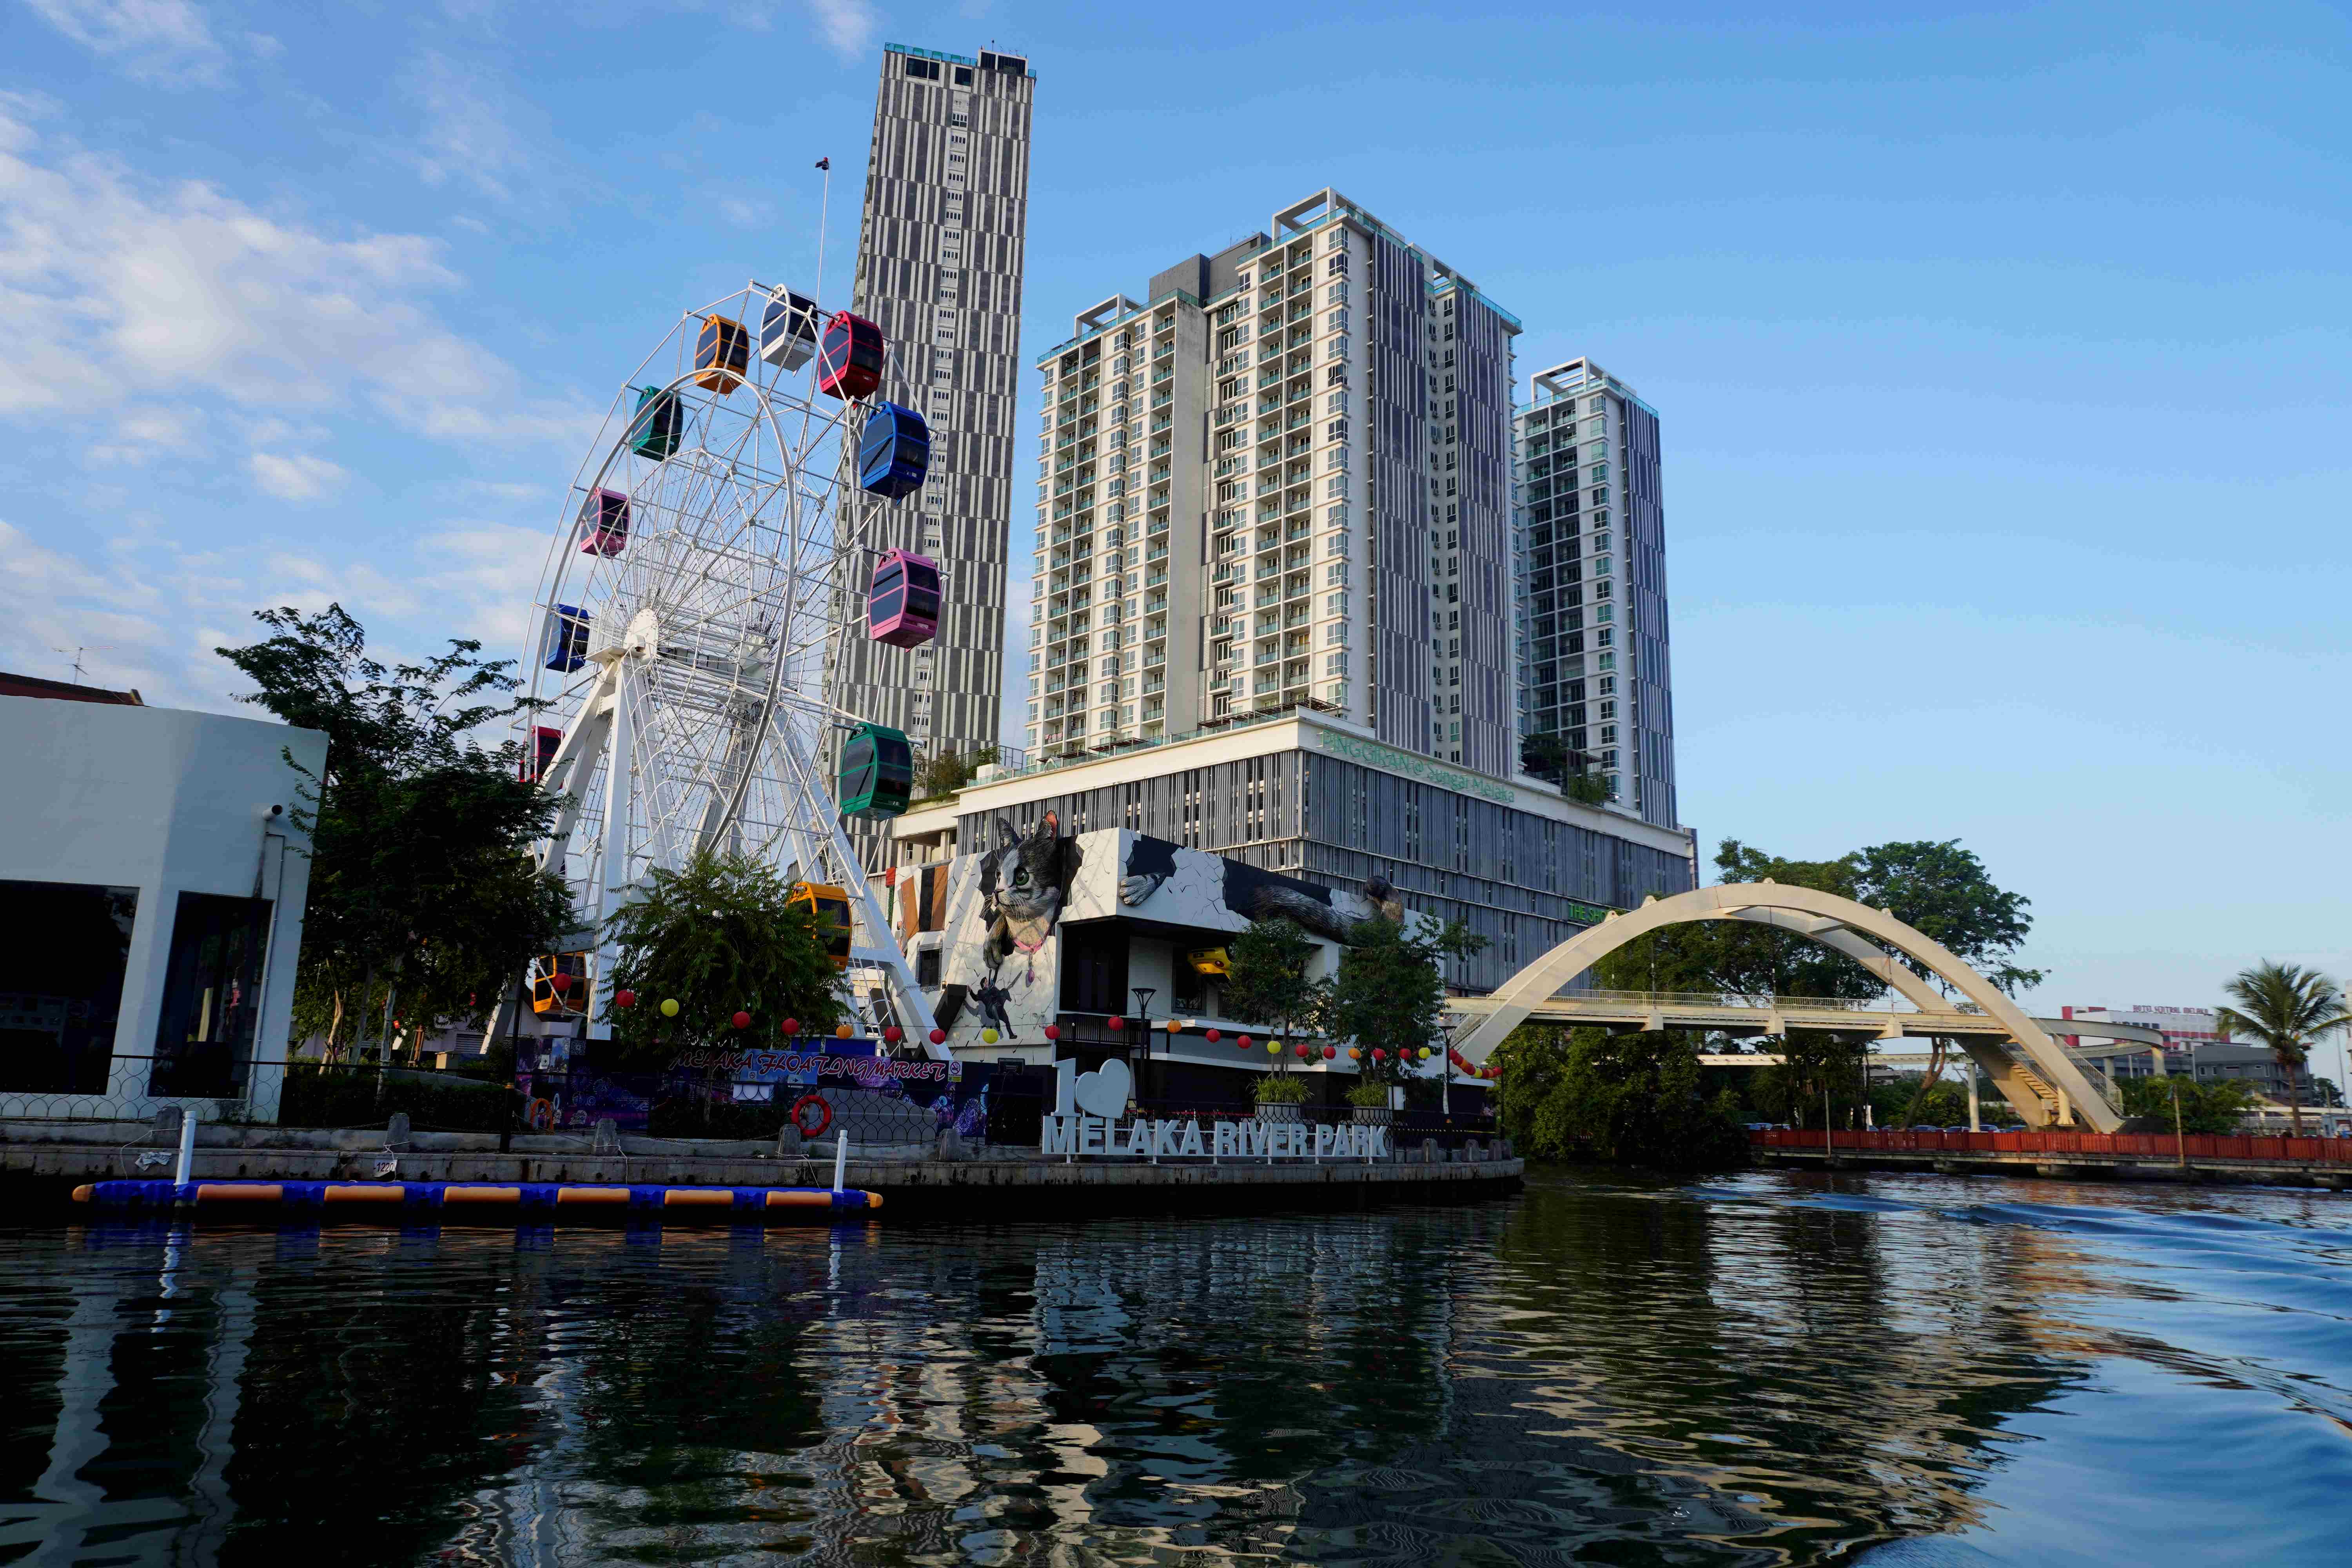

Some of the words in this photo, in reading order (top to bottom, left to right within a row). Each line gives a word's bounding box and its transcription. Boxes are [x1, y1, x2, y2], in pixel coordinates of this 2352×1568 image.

[1412, 759, 1424, 775] @
[1569, 903, 1586, 920] THE
[1589, 908, 1606, 922] SHO
[757, 1052, 869, 1080] FLOATING
[865, 1059, 946, 1081] MARKET
[1042, 1116, 1204, 1155] MELAKA
[1214, 1121, 1308, 1156] RIVER
[1316, 1124, 1388, 1157] PARK
